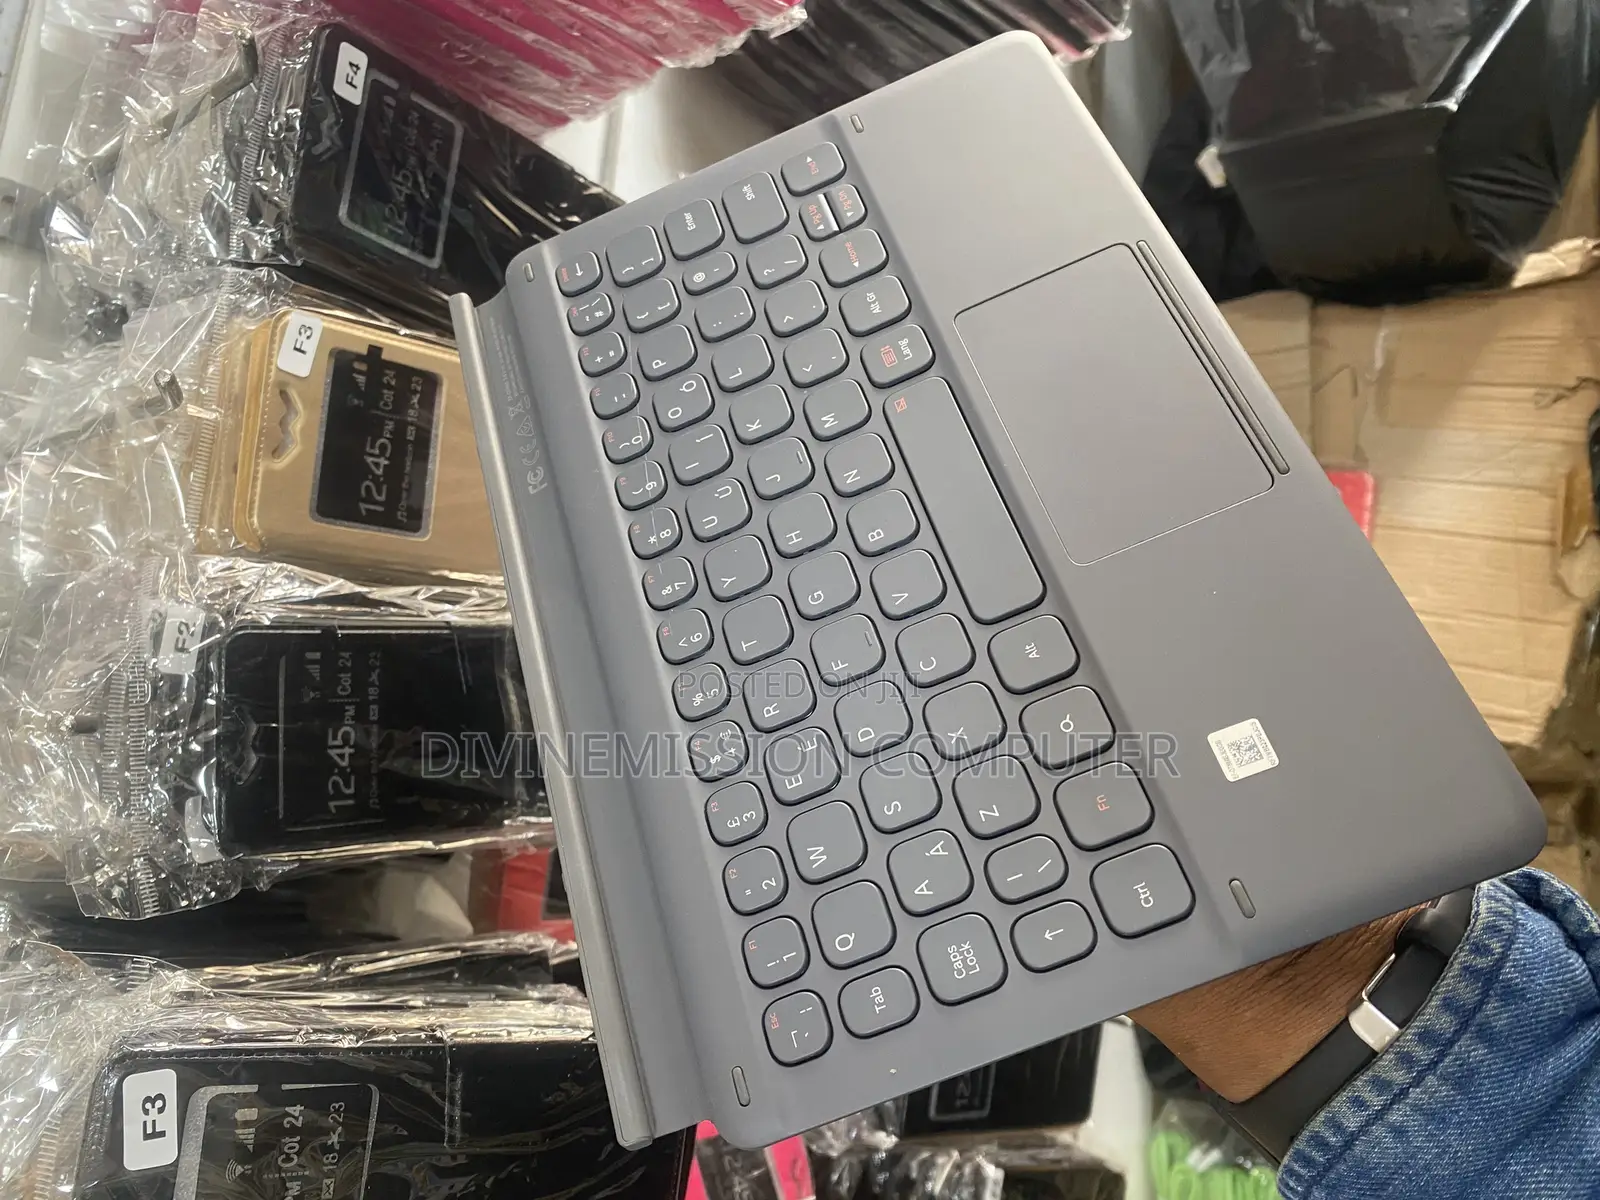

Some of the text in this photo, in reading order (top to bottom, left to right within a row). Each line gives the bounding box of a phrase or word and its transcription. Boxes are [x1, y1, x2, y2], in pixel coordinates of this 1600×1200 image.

[346, 61, 361, 90] F4
[742, 184, 755, 200] Shift
[684, 213, 696, 230] Enter
[845, 242, 857, 263] Home
[866, 292, 882, 314] Alt Gr
[293, 324, 314, 356] F3
[896, 338, 912, 362] Lang
[653, 360, 666, 369] P
[729, 368, 742, 379] L
[380, 368, 396, 411] Cot 24
[411, 376, 423, 392] 23
[408, 408, 419, 424] 18
[668, 407, 682, 418] O
[746, 419, 761, 431] K
[821, 413, 838, 428] M
[358, 418, 396, 516] 12:45 PM
[766, 474, 780, 482] J
[844, 469, 860, 483] N
[646, 482, 656, 490] 9
[703, 516, 717, 528] U
[660, 529, 671, 538] 8
[786, 531, 802, 544] H
[868, 529, 884, 542] B
[674, 582, 686, 590] 7
[721, 577, 736, 588] Y
[809, 591, 824, 604] G
[892, 593, 908, 605] V
[174, 620, 196, 654] F2
[662, 626, 670, 636] F6
[690, 633, 702, 642] 6
[741, 641, 757, 651] T
[1025, 643, 1040, 658] Alt
[832, 660, 848, 670] F
[920, 657, 936, 670] C
[337, 652, 352, 696] Cot 24
[368, 687, 380, 700] 18
[692, 693, 704, 706] %
[706, 688, 719, 698] 5
[764, 703, 779, 717] R
[858, 728, 875, 742] D
[948, 726, 968, 745] X
[724, 747, 736, 756] 4
[328, 705, 356, 814] 12:45 PM
[710, 754, 721, 764] $
[785, 775, 803, 790] E
[711, 802, 719, 812] F3
[884, 801, 901, 815] S
[1096, 794, 1110, 812] Fn
[743, 811, 755, 821] 3
[979, 805, 999, 821] Z
[727, 817, 740, 827] £
[807, 847, 827, 868] W
[730, 868, 738, 879] F2
[762, 878, 776, 889] 2
[914, 880, 933, 894] A
[1133, 882, 1153, 907] Ctrl
[749, 939, 757, 950] F1
[835, 933, 854, 951] Q
[783, 952, 796, 961] 1
[947, 944, 966, 979] Caps
[961, 940, 980, 975] Lock
[870, 987, 886, 1013] Tab
[141, 1092, 168, 1142] F3
[328, 1102, 346, 1124] 23
[278, 1104, 304, 1168] Cot 24
[322, 1152, 339, 1172] 18
